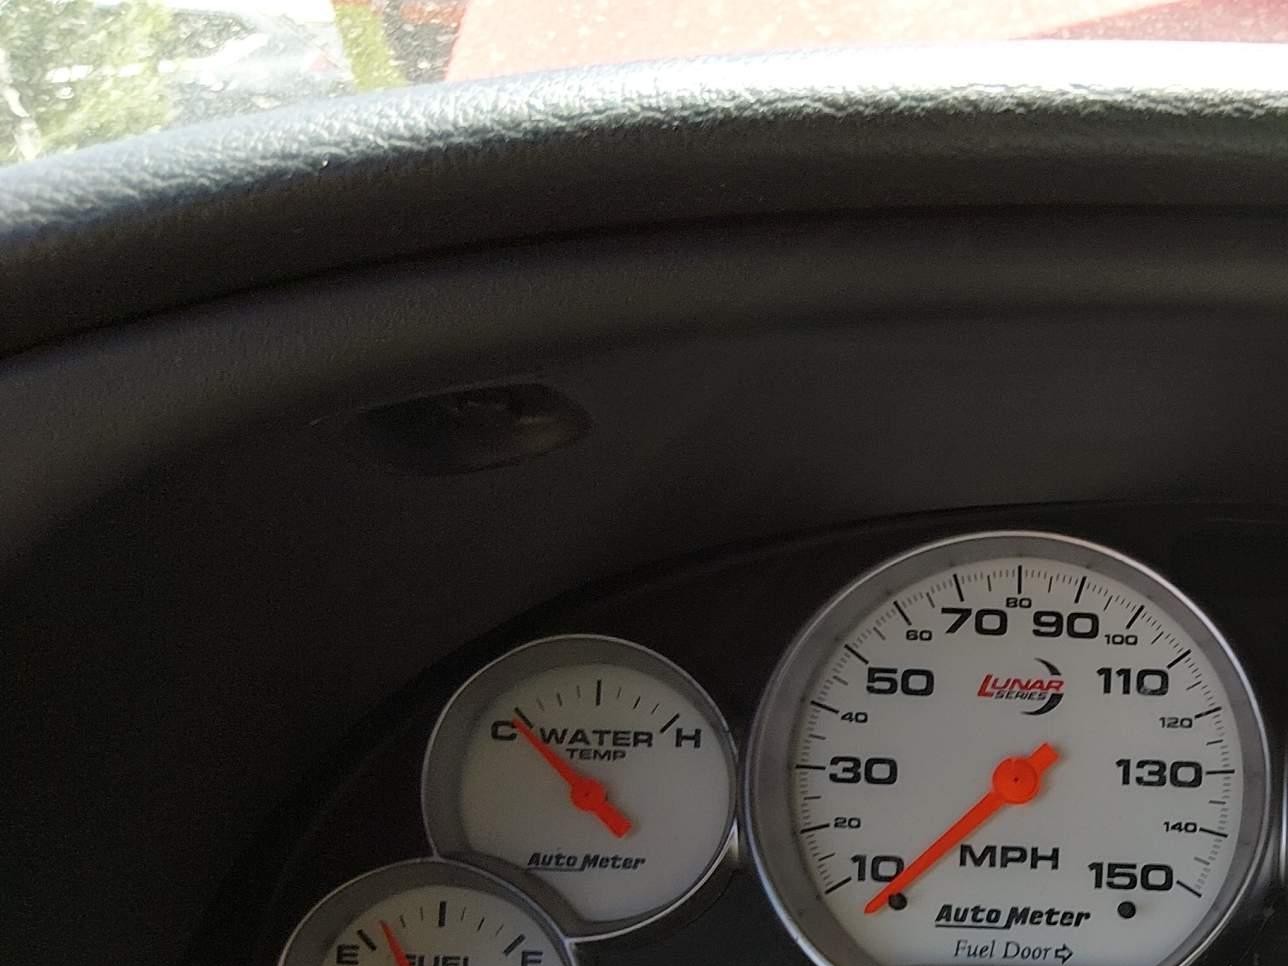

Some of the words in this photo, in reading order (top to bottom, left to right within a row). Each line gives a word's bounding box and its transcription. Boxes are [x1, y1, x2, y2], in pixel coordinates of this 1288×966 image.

[1005, 596, 1033, 609] 80
[941, 608, 1008, 635] 70
[1032, 611, 1099, 639] 90
[906, 629, 933, 642] 60
[1104, 633, 1138, 646] 100
[866, 668, 935, 696] 50
[1097, 667, 1169, 696] 110
[994, 691, 1048, 700] SERIES
[841, 711, 869, 724] 40
[1159, 716, 1193, 729] 120
[490, 720, 518, 741] C
[540, 728, 653, 747] WATER
[675, 728, 701, 748] H
[564, 748, 626, 761] TEMP
[829, 756, 898, 784] 30
[1115, 758, 1202, 788] 130
[834, 817, 861, 829] 20
[1163, 821, 1197, 833] 140
[959, 845, 1060, 870] MPH
[851, 855, 904, 882] 10
[1088, 862, 1174, 891] 150
[336, 944, 360, 965] E
[954, 940, 995, 959] Fuel
[1003, 941, 1052, 960] Door
